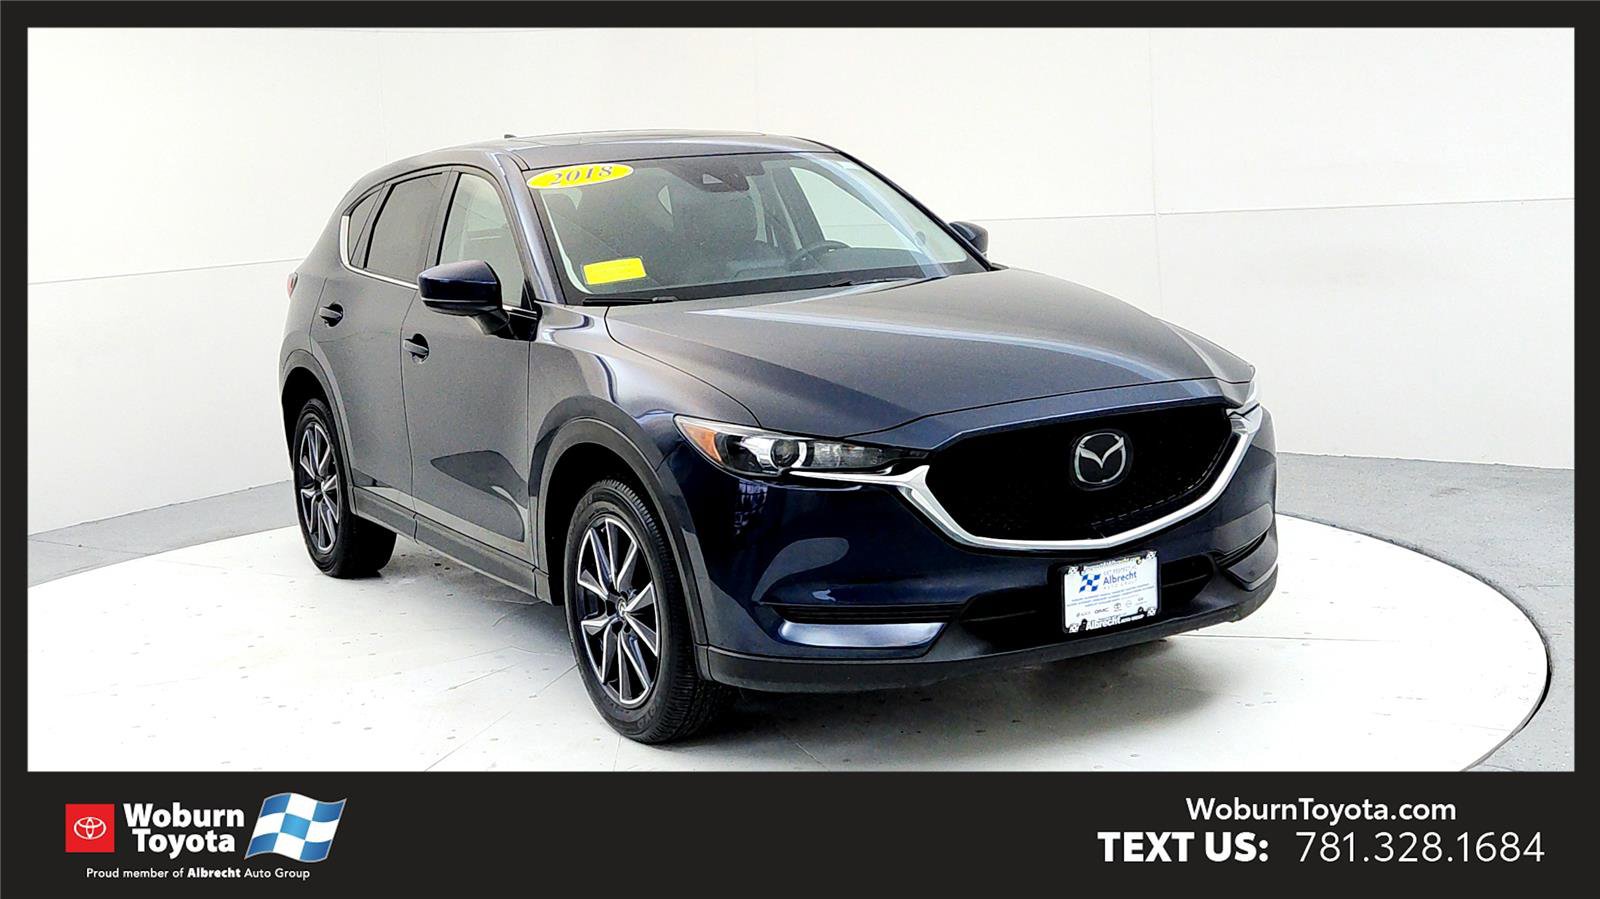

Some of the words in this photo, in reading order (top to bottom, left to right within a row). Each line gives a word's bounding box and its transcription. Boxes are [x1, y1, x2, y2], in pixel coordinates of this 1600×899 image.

[550, 166, 613, 185] 2018
[1103, 571, 1137, 585] Albrecht
[1086, 615, 1121, 630] Albrecht
